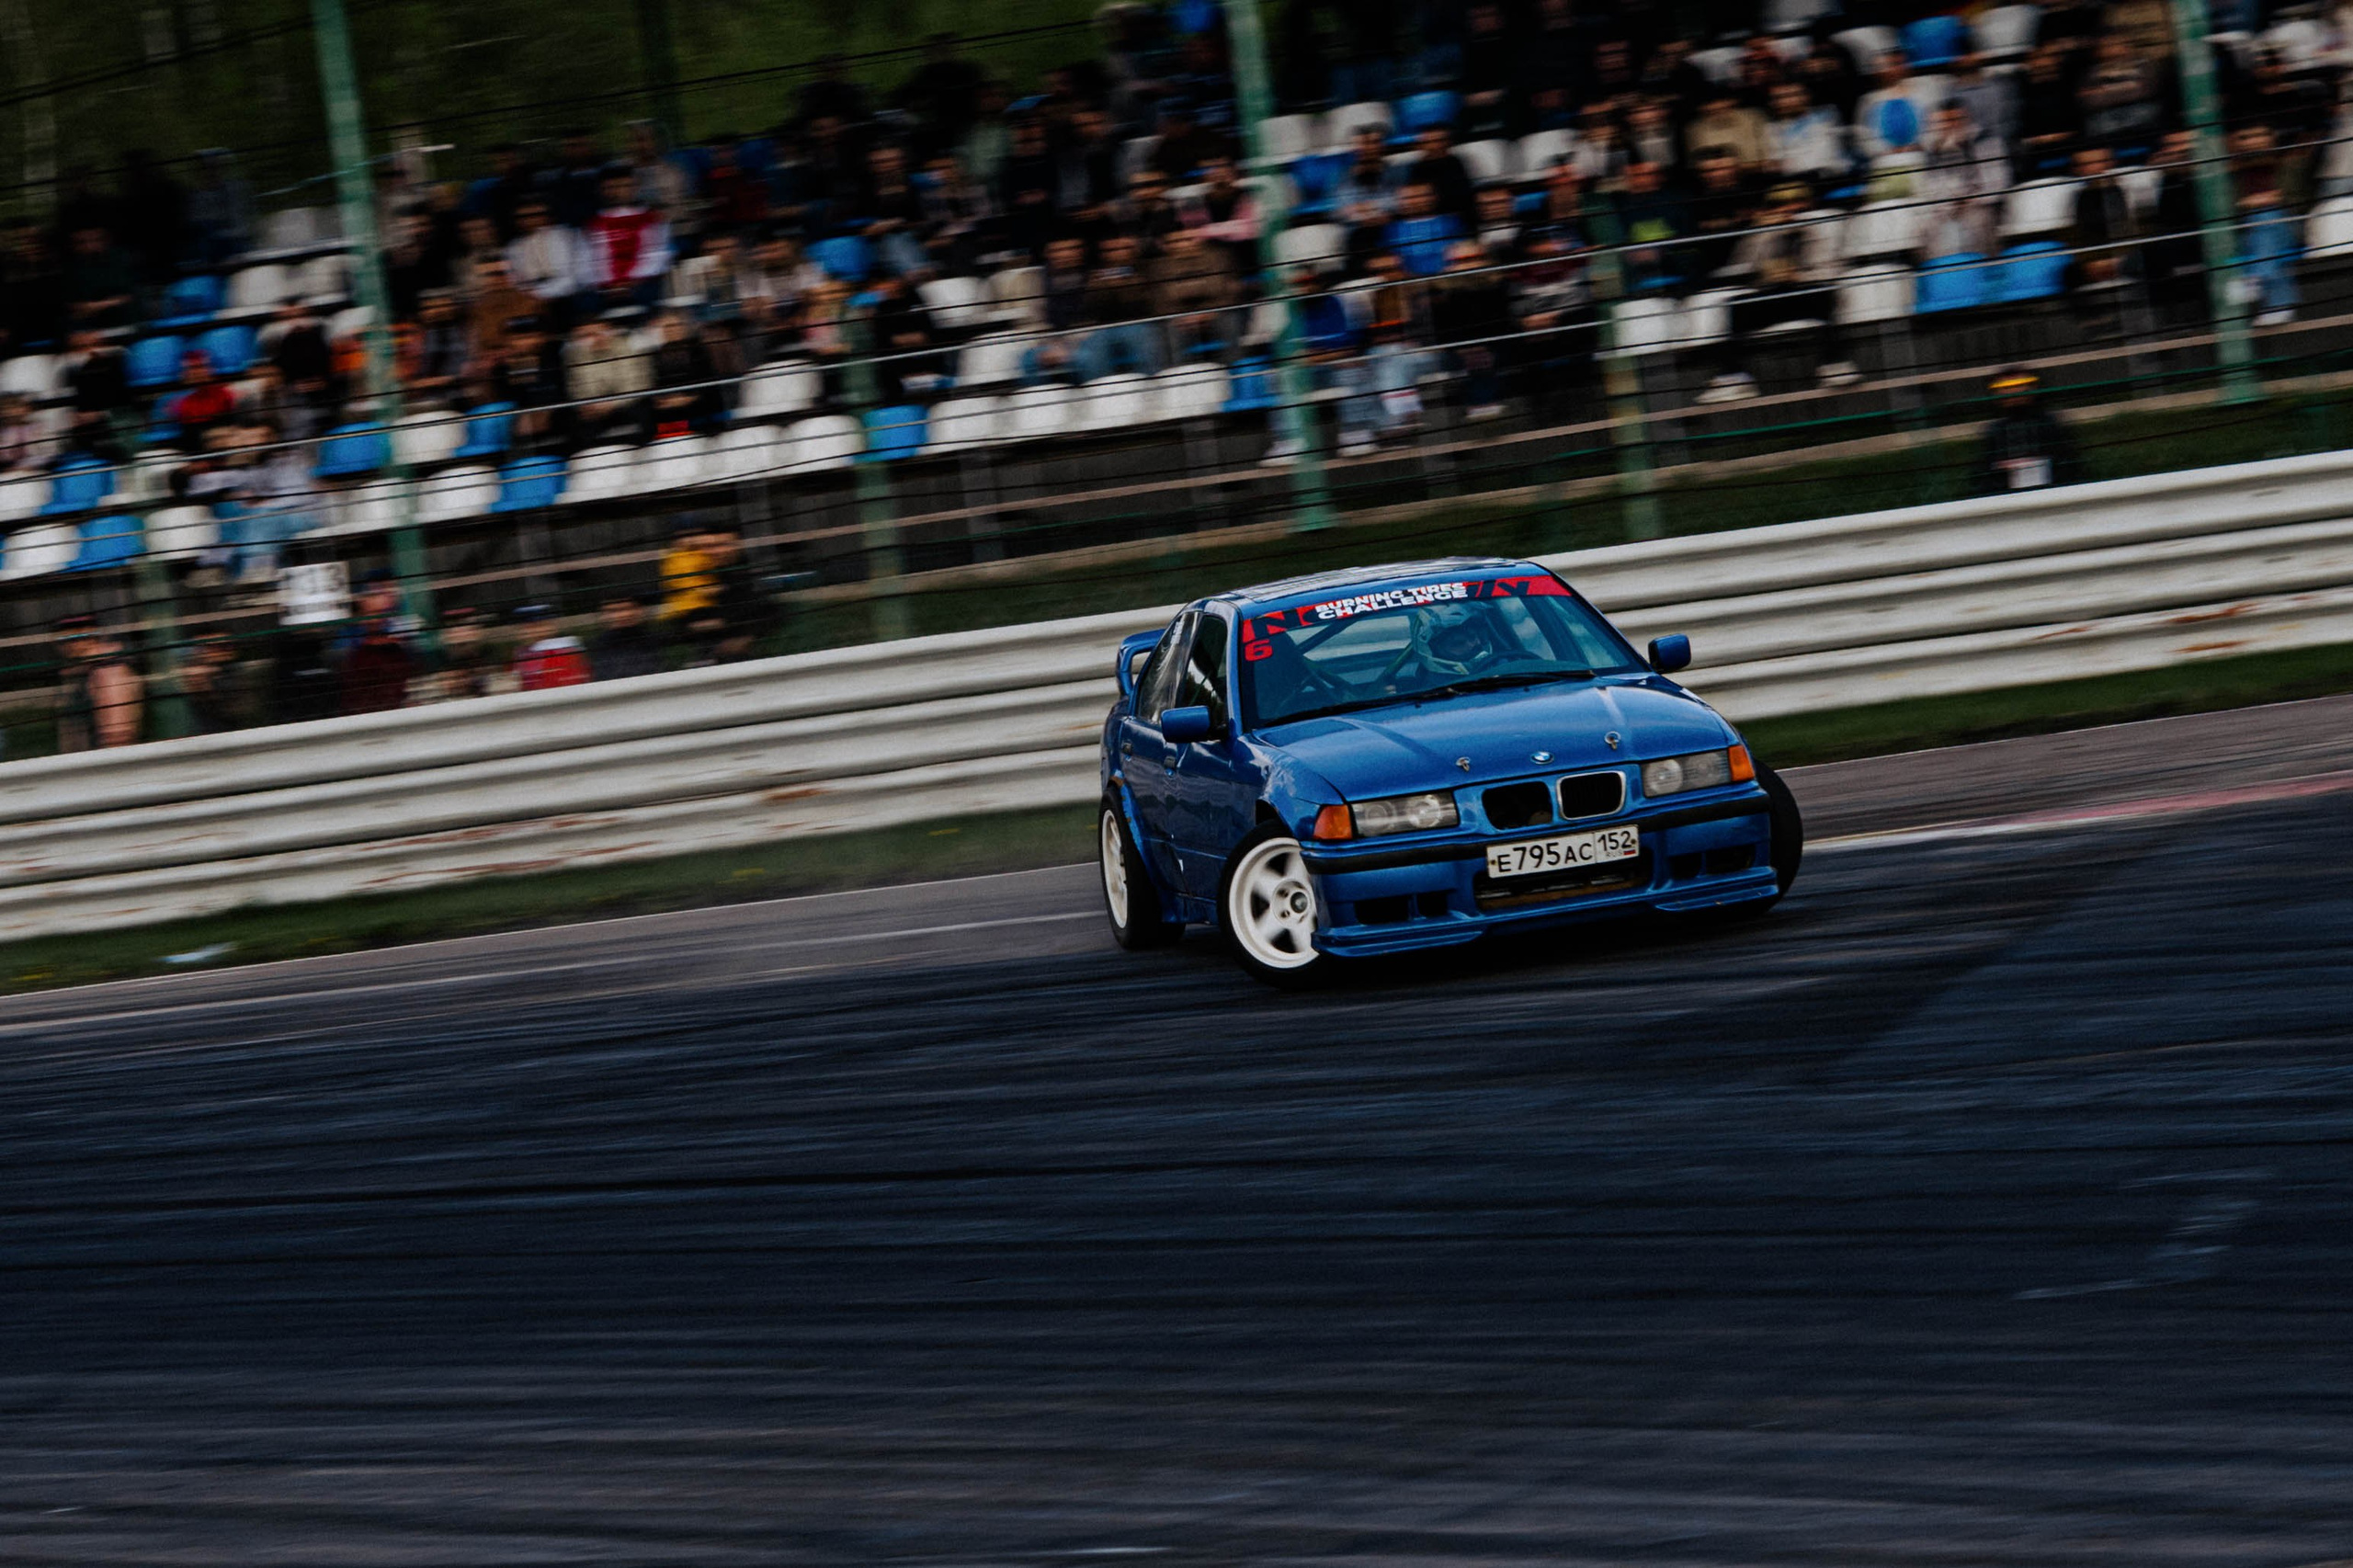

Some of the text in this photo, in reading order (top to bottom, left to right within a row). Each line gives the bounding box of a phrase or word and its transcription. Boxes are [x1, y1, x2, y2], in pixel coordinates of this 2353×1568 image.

[1315, 590, 1403, 613] BURNING
[1407, 583, 1465, 597] TIRES
[1318, 589, 1469, 619] CHALLENGE
[1245, 639, 1273, 661] 6
[1597, 830, 1631, 851] 152
